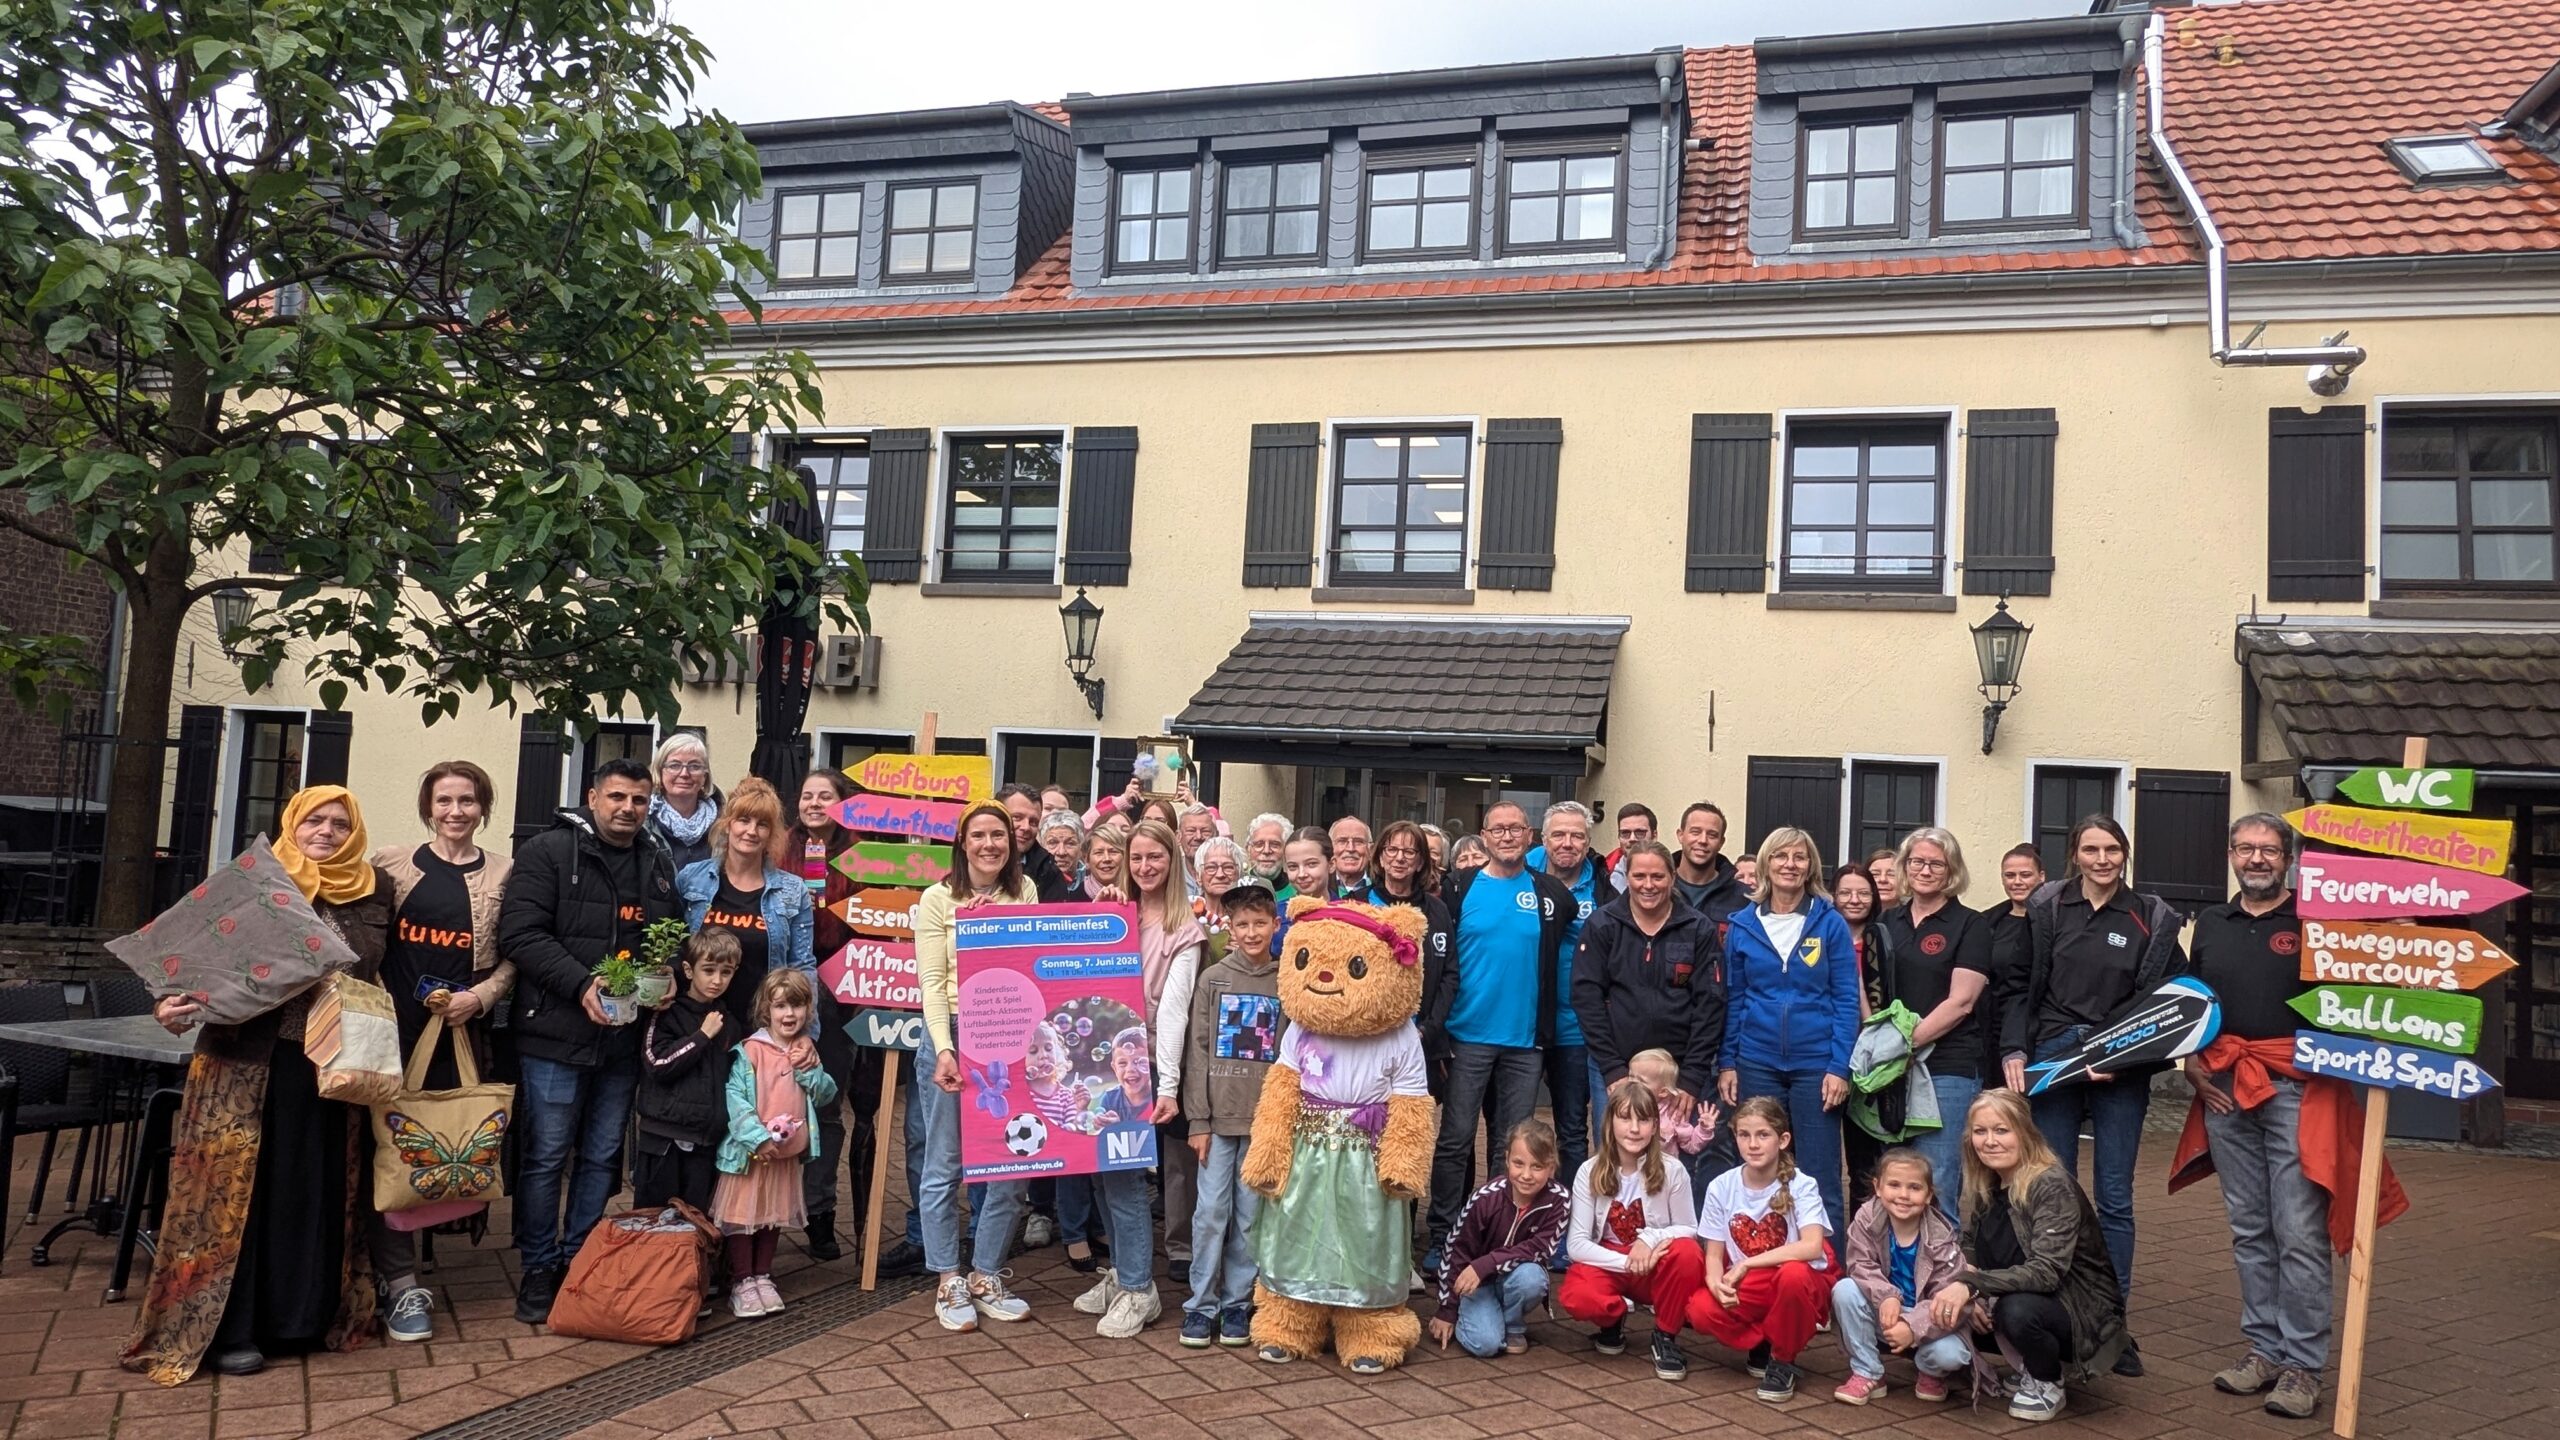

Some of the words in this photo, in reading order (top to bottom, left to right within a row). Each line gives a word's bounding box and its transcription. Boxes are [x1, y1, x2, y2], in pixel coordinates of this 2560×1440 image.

[863, 760, 970, 800] Hüpfburg
[2377, 770, 2453, 806] WC
[842, 803, 957, 837] Kinderthea
[2302, 808, 2496, 867] Kindertheater
[2299, 866, 2470, 910] Feuerwehr
[399, 918, 472, 948] tuwa
[958, 923, 1004, 936] Kinder-
[1008, 921, 1032, 932] und
[1035, 919, 1109, 932] Familienfest
[1042, 959, 1082, 970] Sonntag,
[1084, 958, 1093, 967] 7.
[1095, 957, 1114, 967] Juni
[1116, 956, 1138, 966] 2026
[2314, 950, 2460, 990] Parcours
[972, 998, 993, 1007] Sport
[1004, 996, 1021, 1005] Spiel
[974, 985, 1018, 994] Kinderdisco
[962, 1007, 1032, 1018] Mitmach-Aktionen
[963, 1018, 1032, 1029] Luftballonkünstler
[2316, 990, 2465, 1047] Ballons
[868, 1014, 923, 1048] WC
[970, 1029, 1026, 1039] Puppentheater
[974, 1040, 1022, 1049] Kindertrödel
[2105, 1024, 2157, 1055] 7000
[1106, 1129, 1150, 1159] NV
[966, 1160, 1064, 1176] www.neukirchen-vluyn.de
